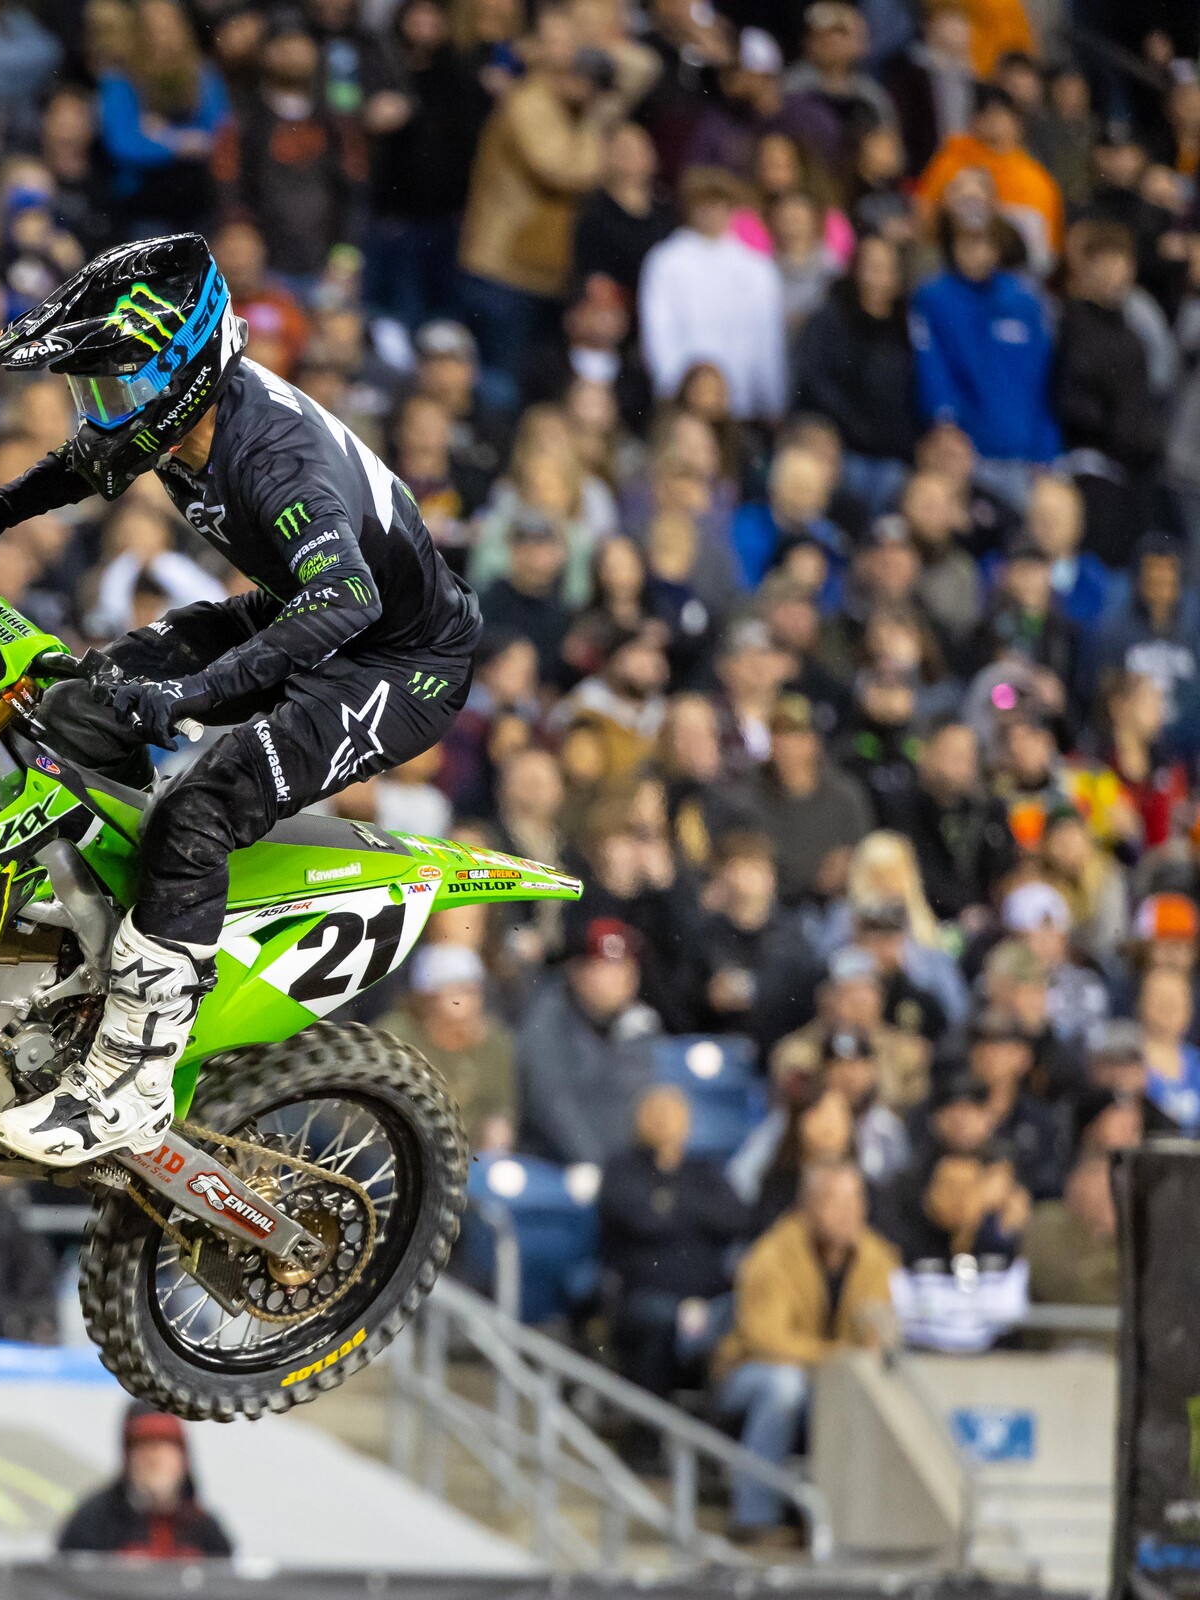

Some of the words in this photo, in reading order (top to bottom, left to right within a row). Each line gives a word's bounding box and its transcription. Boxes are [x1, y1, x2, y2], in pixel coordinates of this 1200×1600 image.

[157, 366, 211, 430] MONSTER
[174, 381, 211, 427] ENERGY
[253, 720, 291, 802] Kawasaki
[307, 863, 362, 882] Kawasaki
[448, 881, 516, 893] DUNLOP
[469, 869, 520, 880] GEARWRENCH
[407, 883, 432, 895] AMA
[287, 903, 406, 1003] 21
